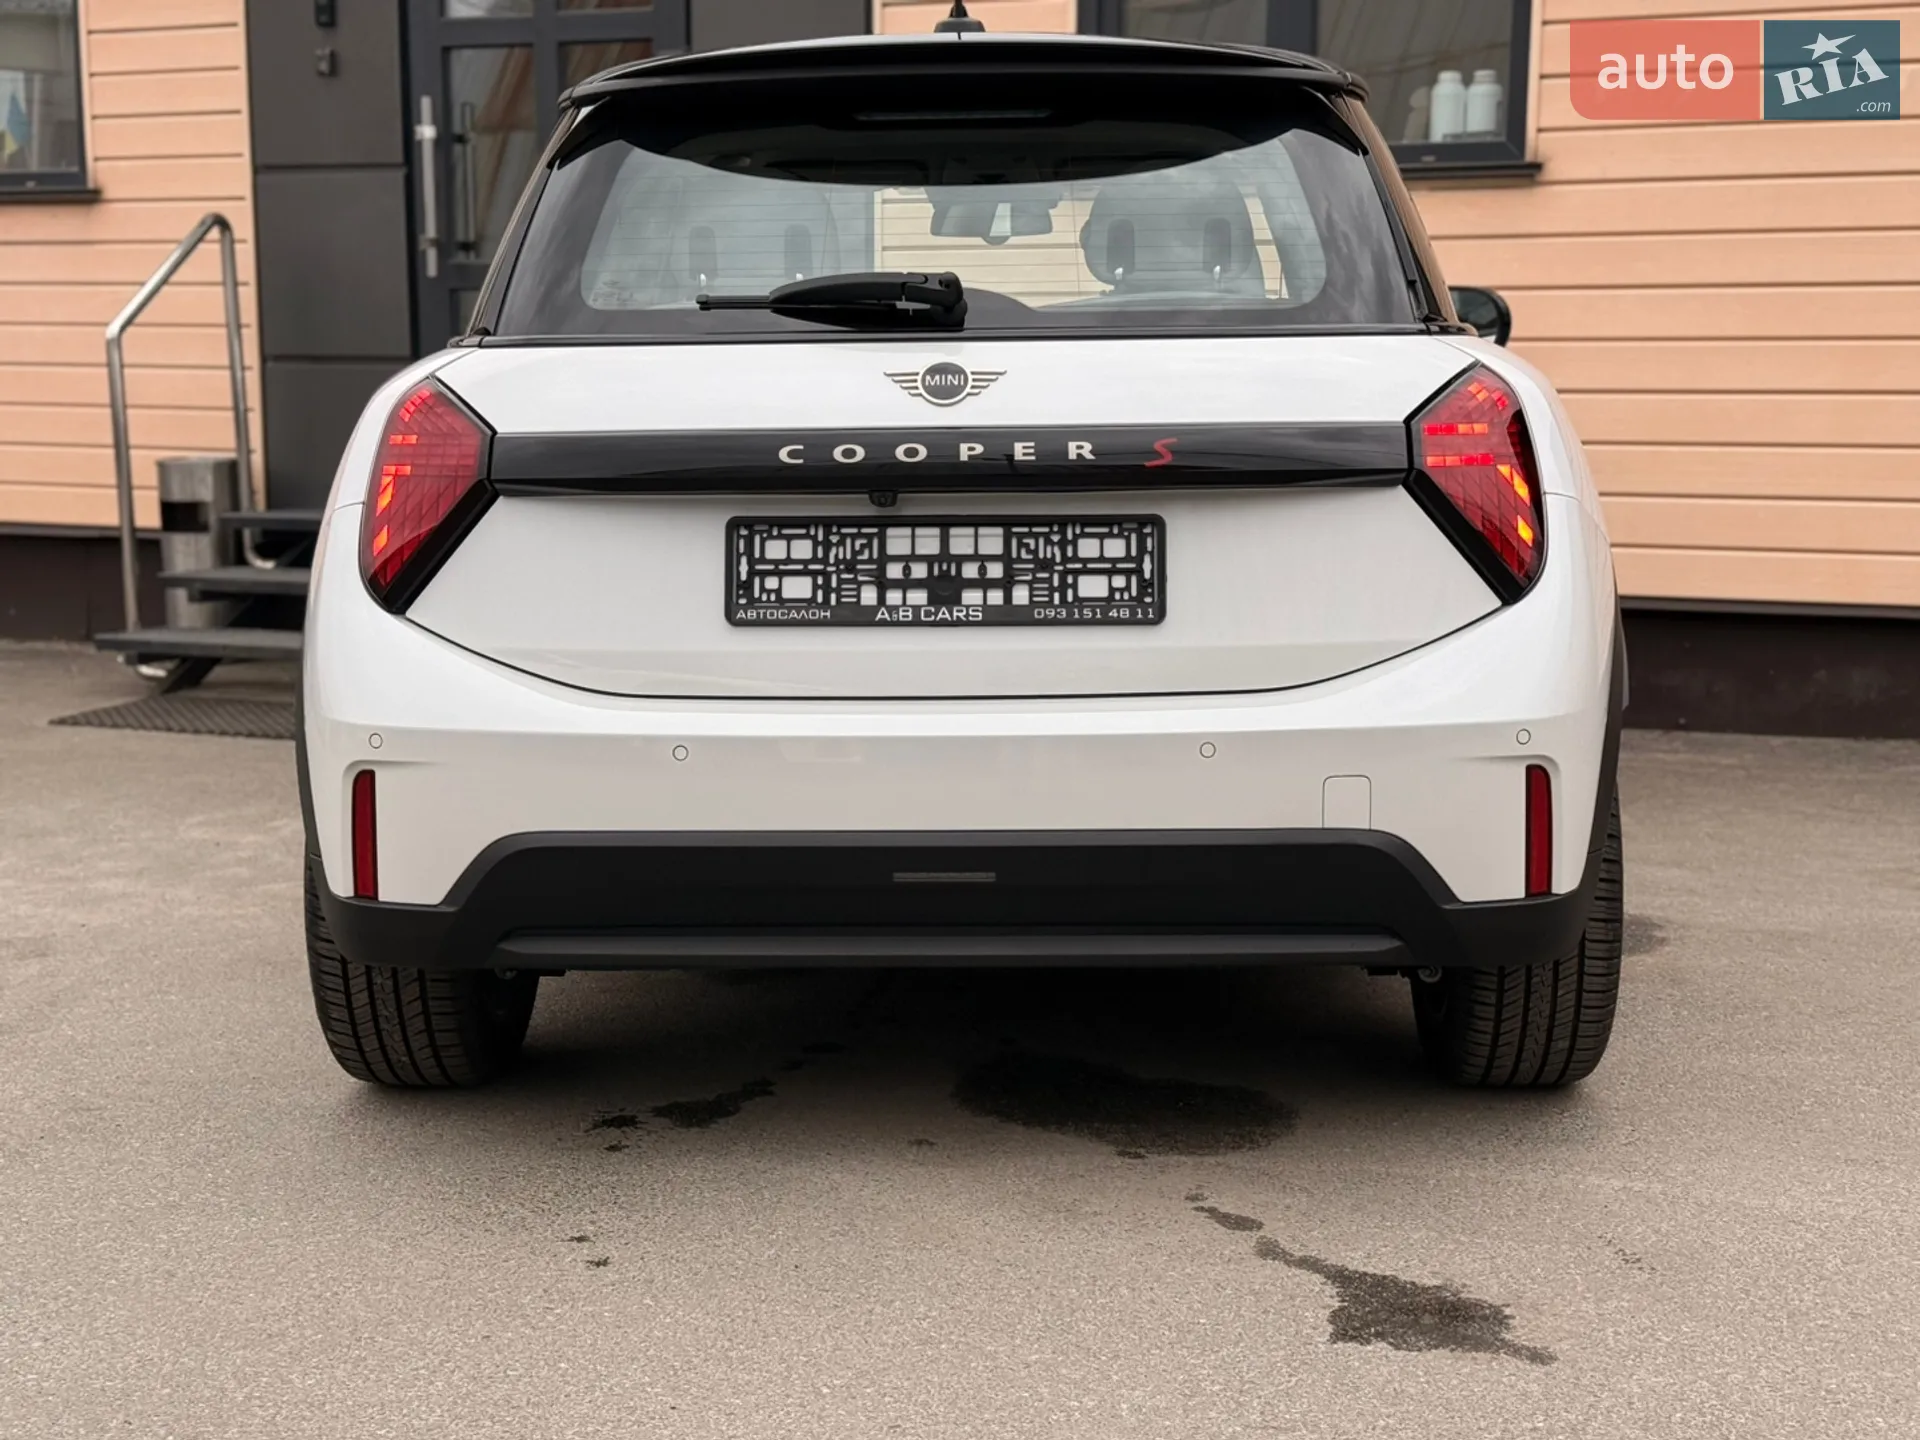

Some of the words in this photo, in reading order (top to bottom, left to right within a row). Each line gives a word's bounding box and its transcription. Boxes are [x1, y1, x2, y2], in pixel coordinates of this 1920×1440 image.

[925, 374, 965, 386] MINI
[778, 441, 1096, 464] COOPER
[1144, 438, 1178, 467] S
[736, 609, 831, 620] АВТОСАЛОН
[920, 606, 983, 621] CARS
[1034, 608, 1067, 619] 093
[1073, 608, 1102, 619] 151
[1108, 608, 1130, 619] 48
